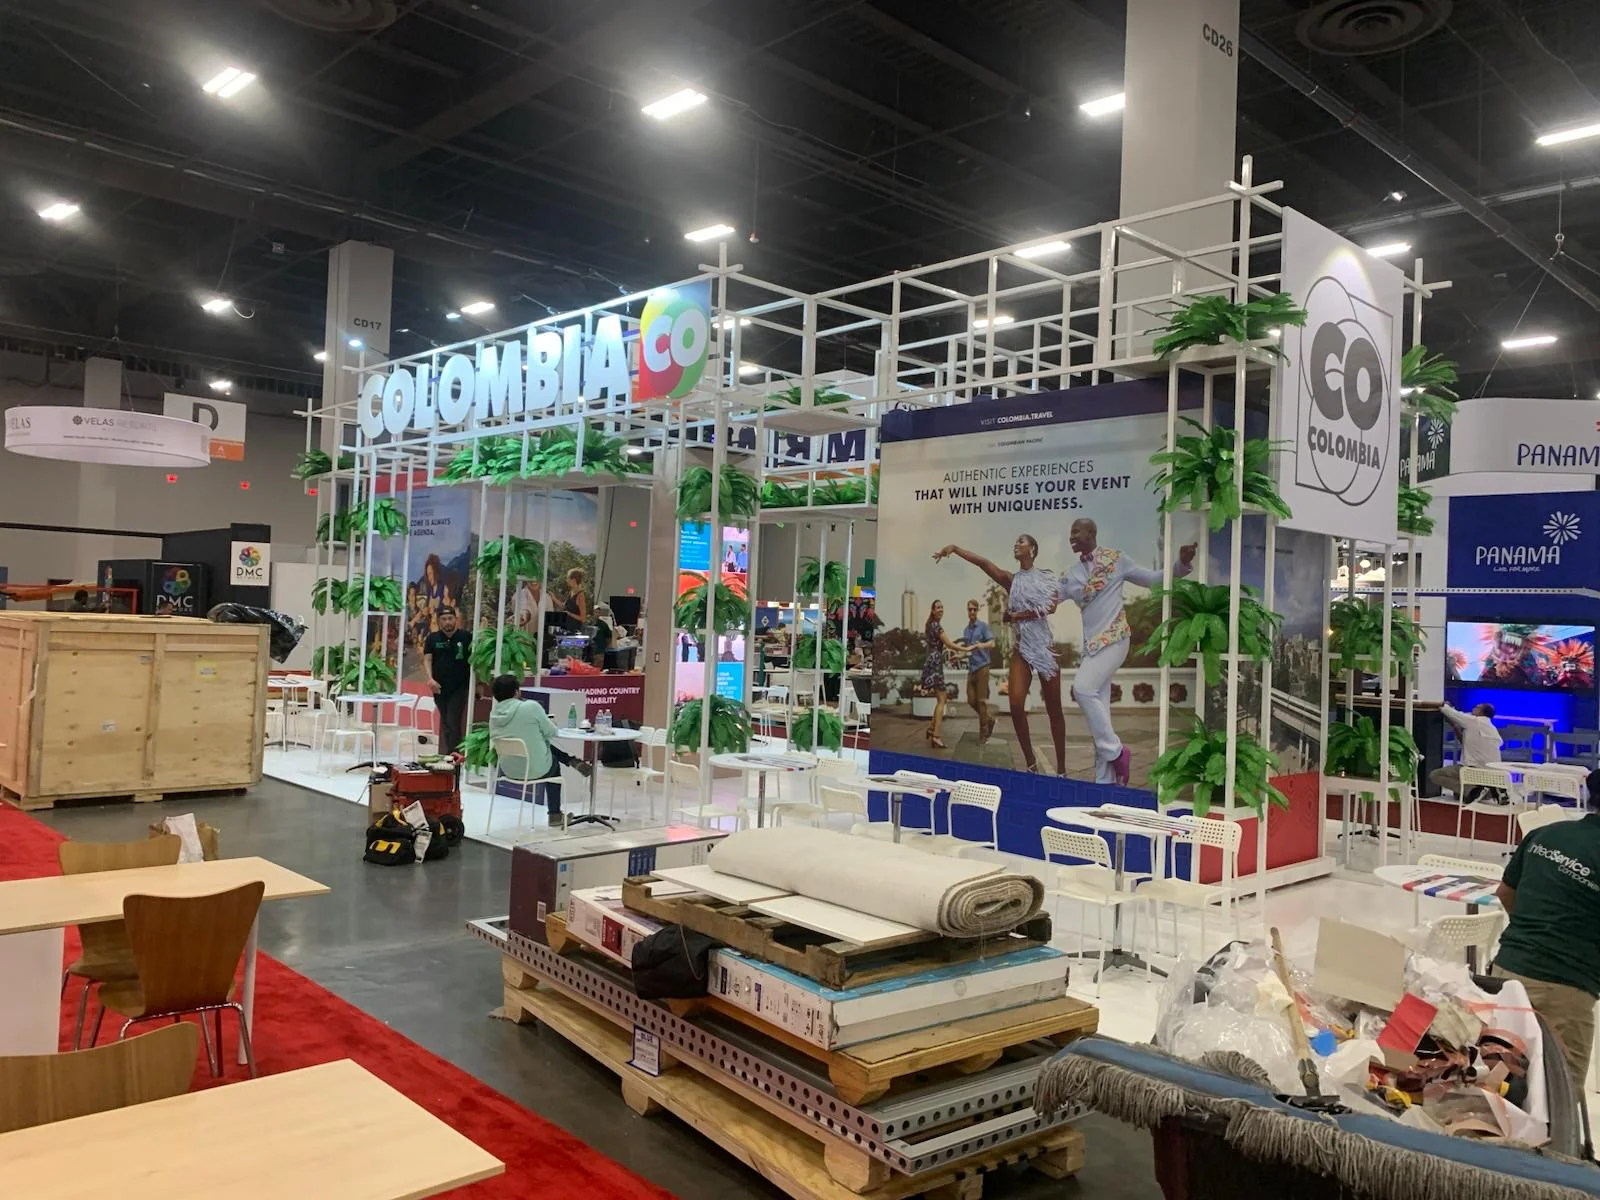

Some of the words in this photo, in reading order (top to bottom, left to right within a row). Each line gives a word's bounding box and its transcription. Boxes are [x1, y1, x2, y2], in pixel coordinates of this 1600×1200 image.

[1202, 23, 1233, 57] CD26
[353, 318, 382, 330] CD17
[642, 308, 708, 373] CO
[358, 314, 630, 439] COLOMBIA
[1310, 321, 1383, 431] CO
[9, 416, 31, 430] ELAS
[83, 417, 114, 427] VELAS
[192, 402, 219, 431] D
[997, 411, 1053, 424] COLOMBIA.TRAVEL
[1308, 426, 1380, 470] COLOMBIA
[943, 467, 1010, 483] AUTHENTIC
[1011, 460, 1094, 478] EXPERIENCES
[1400, 450, 1436, 478] PAAMA
[914, 487, 944, 501] THAT
[949, 484, 978, 499] WILL
[982, 482, 1030, 497] INFUSE
[1035, 479, 1076, 494] YOUR
[1082, 475, 1131, 491] EVENT
[949, 502, 982, 515] WITH
[987, 497, 1083, 513] UNIQUENESS.
[410, 519, 423, 527] COME
[236, 566, 263, 577] DMC
[156, 595, 193, 608] DMC
[609, 686, 640, 695] COUNTRY
[586, 696, 617, 704] INABILITY
